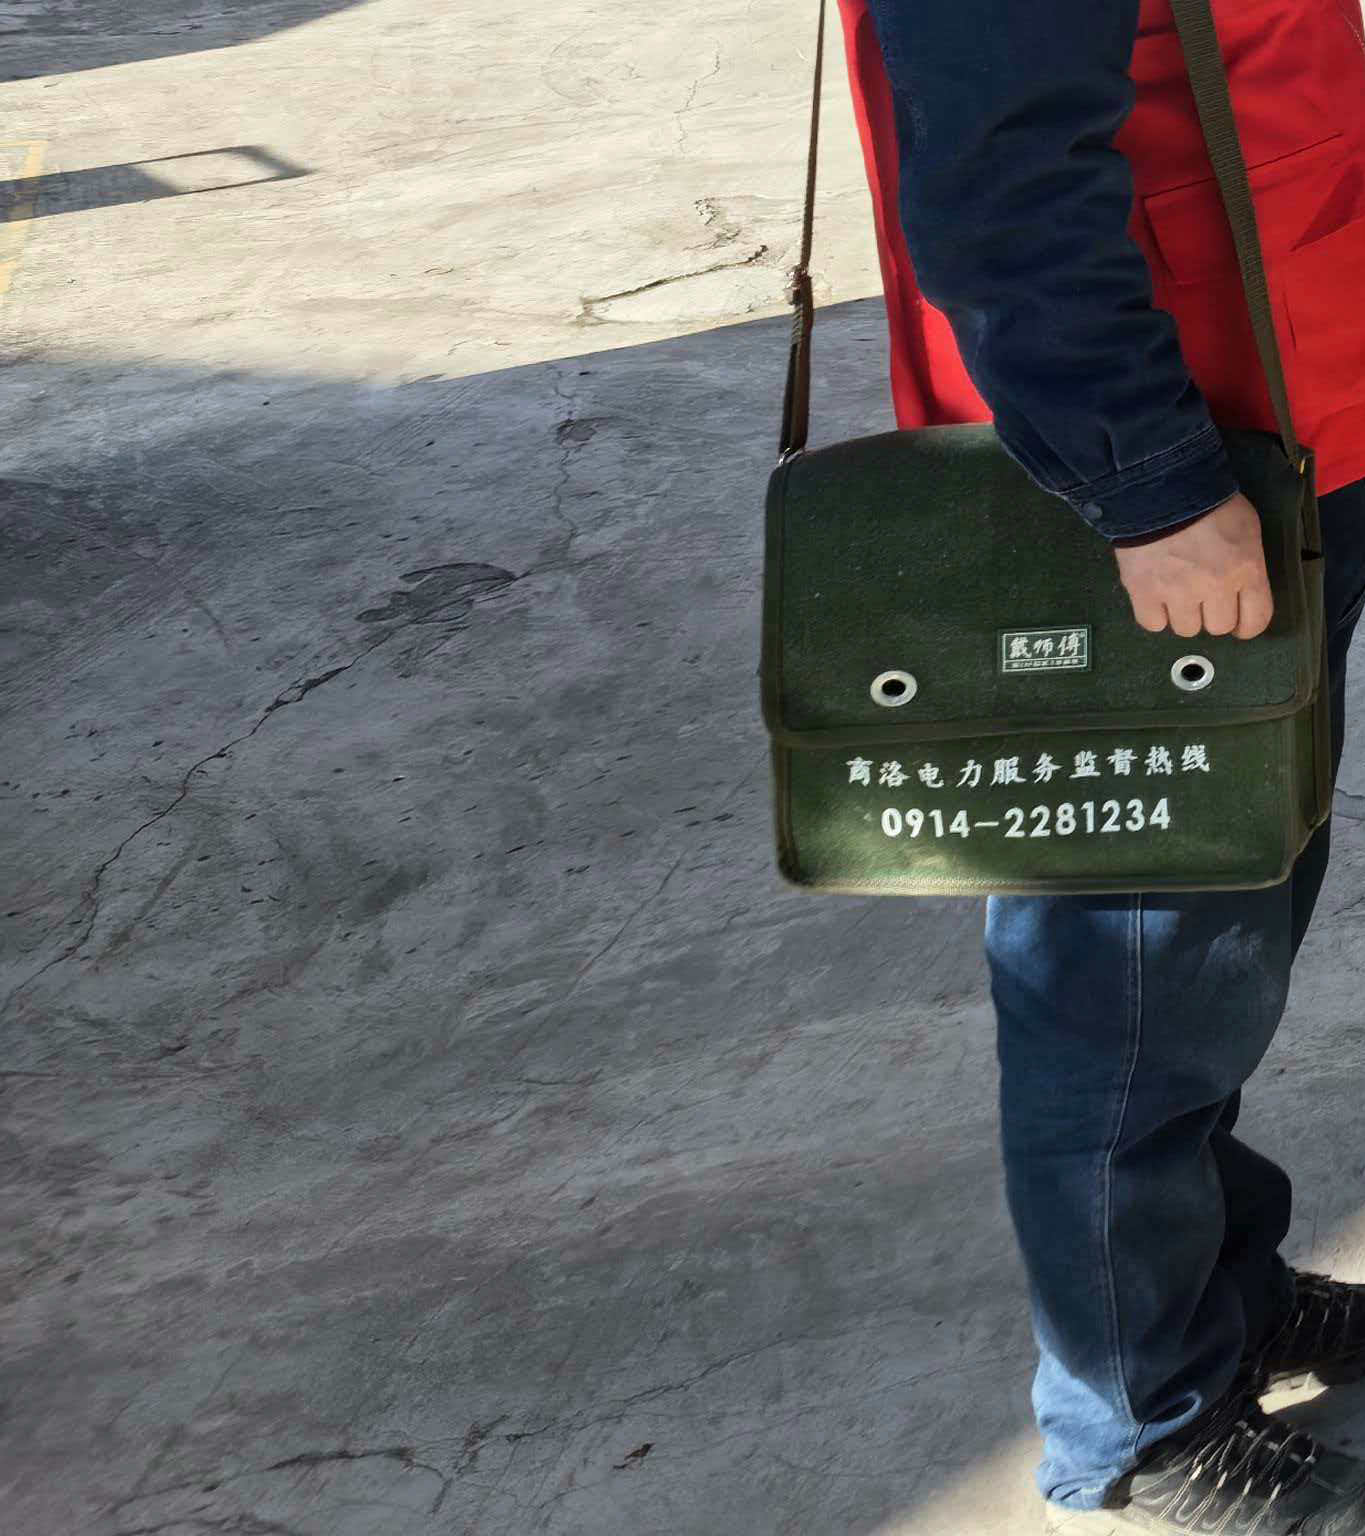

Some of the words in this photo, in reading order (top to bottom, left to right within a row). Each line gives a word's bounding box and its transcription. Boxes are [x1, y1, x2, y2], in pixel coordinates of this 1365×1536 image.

[845, 743, 1211, 789] 商洛电力服务监督热线
[880, 797, 1172, 839] 0914-2281234
